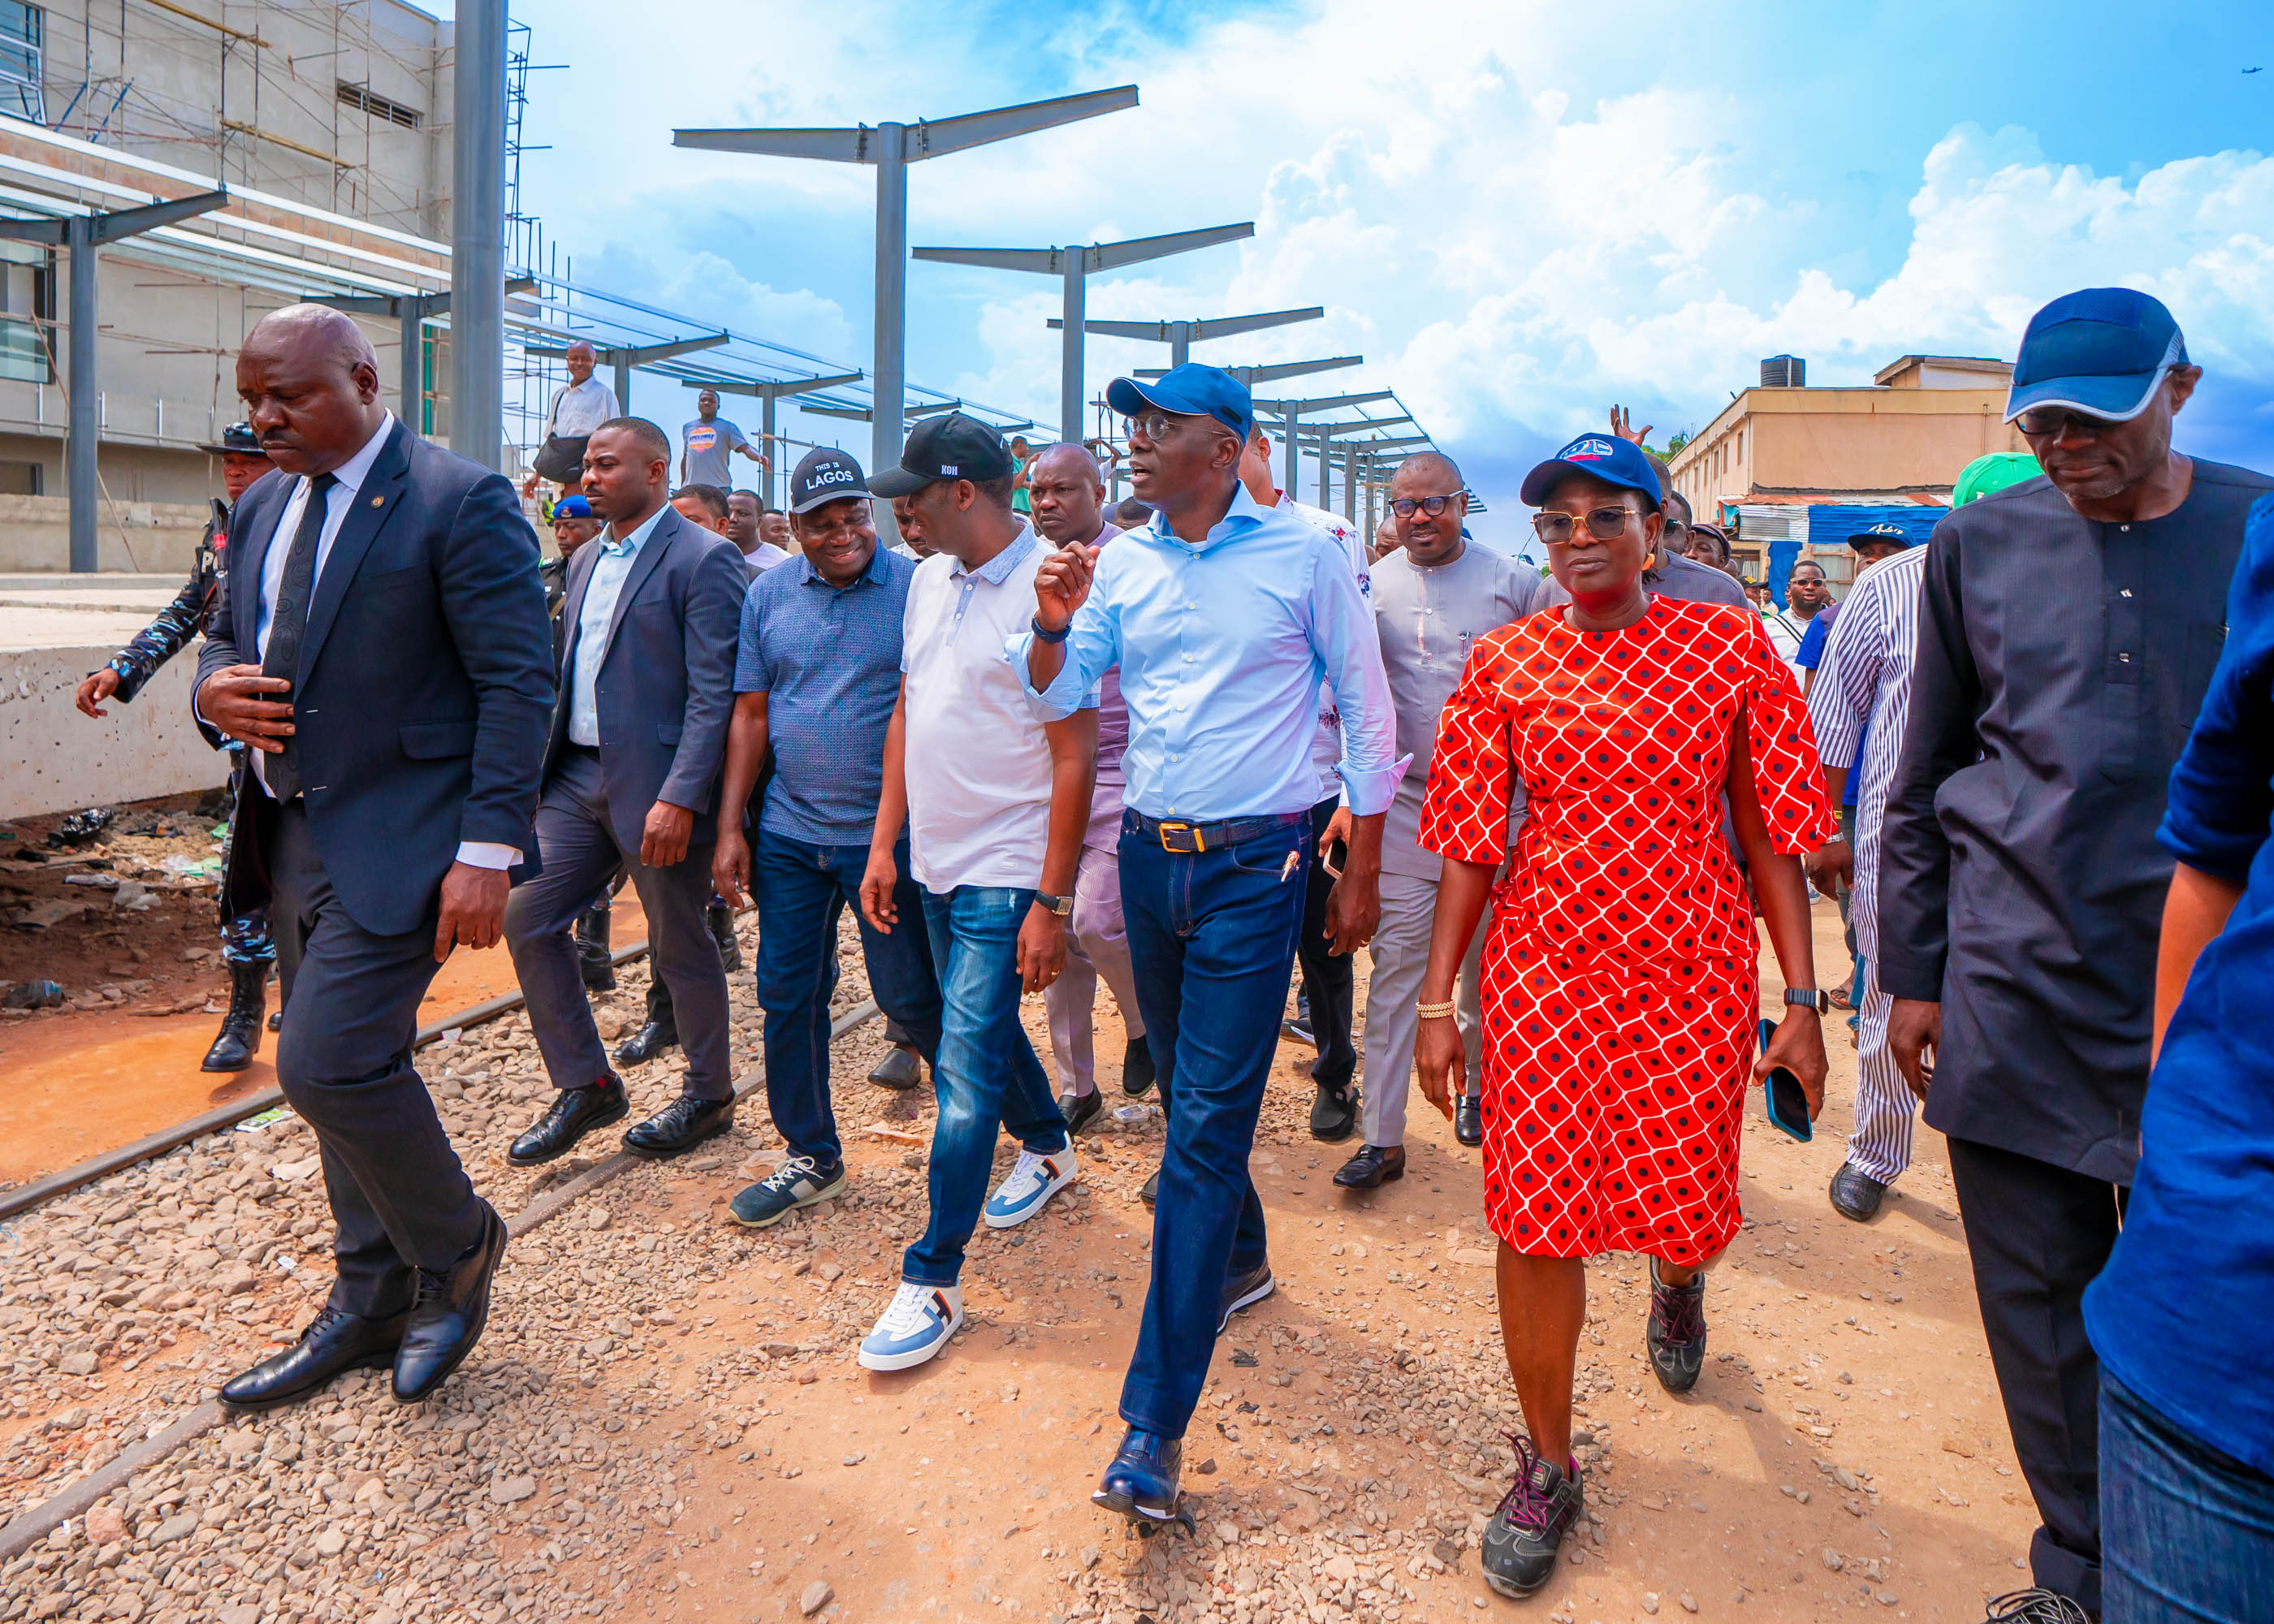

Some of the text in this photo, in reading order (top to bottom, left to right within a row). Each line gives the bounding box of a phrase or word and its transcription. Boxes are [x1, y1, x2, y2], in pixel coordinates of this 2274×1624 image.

[815, 463, 831, 472] THIS
[941, 464, 958, 476] KOH
[806, 470, 854, 490] LAGOS
